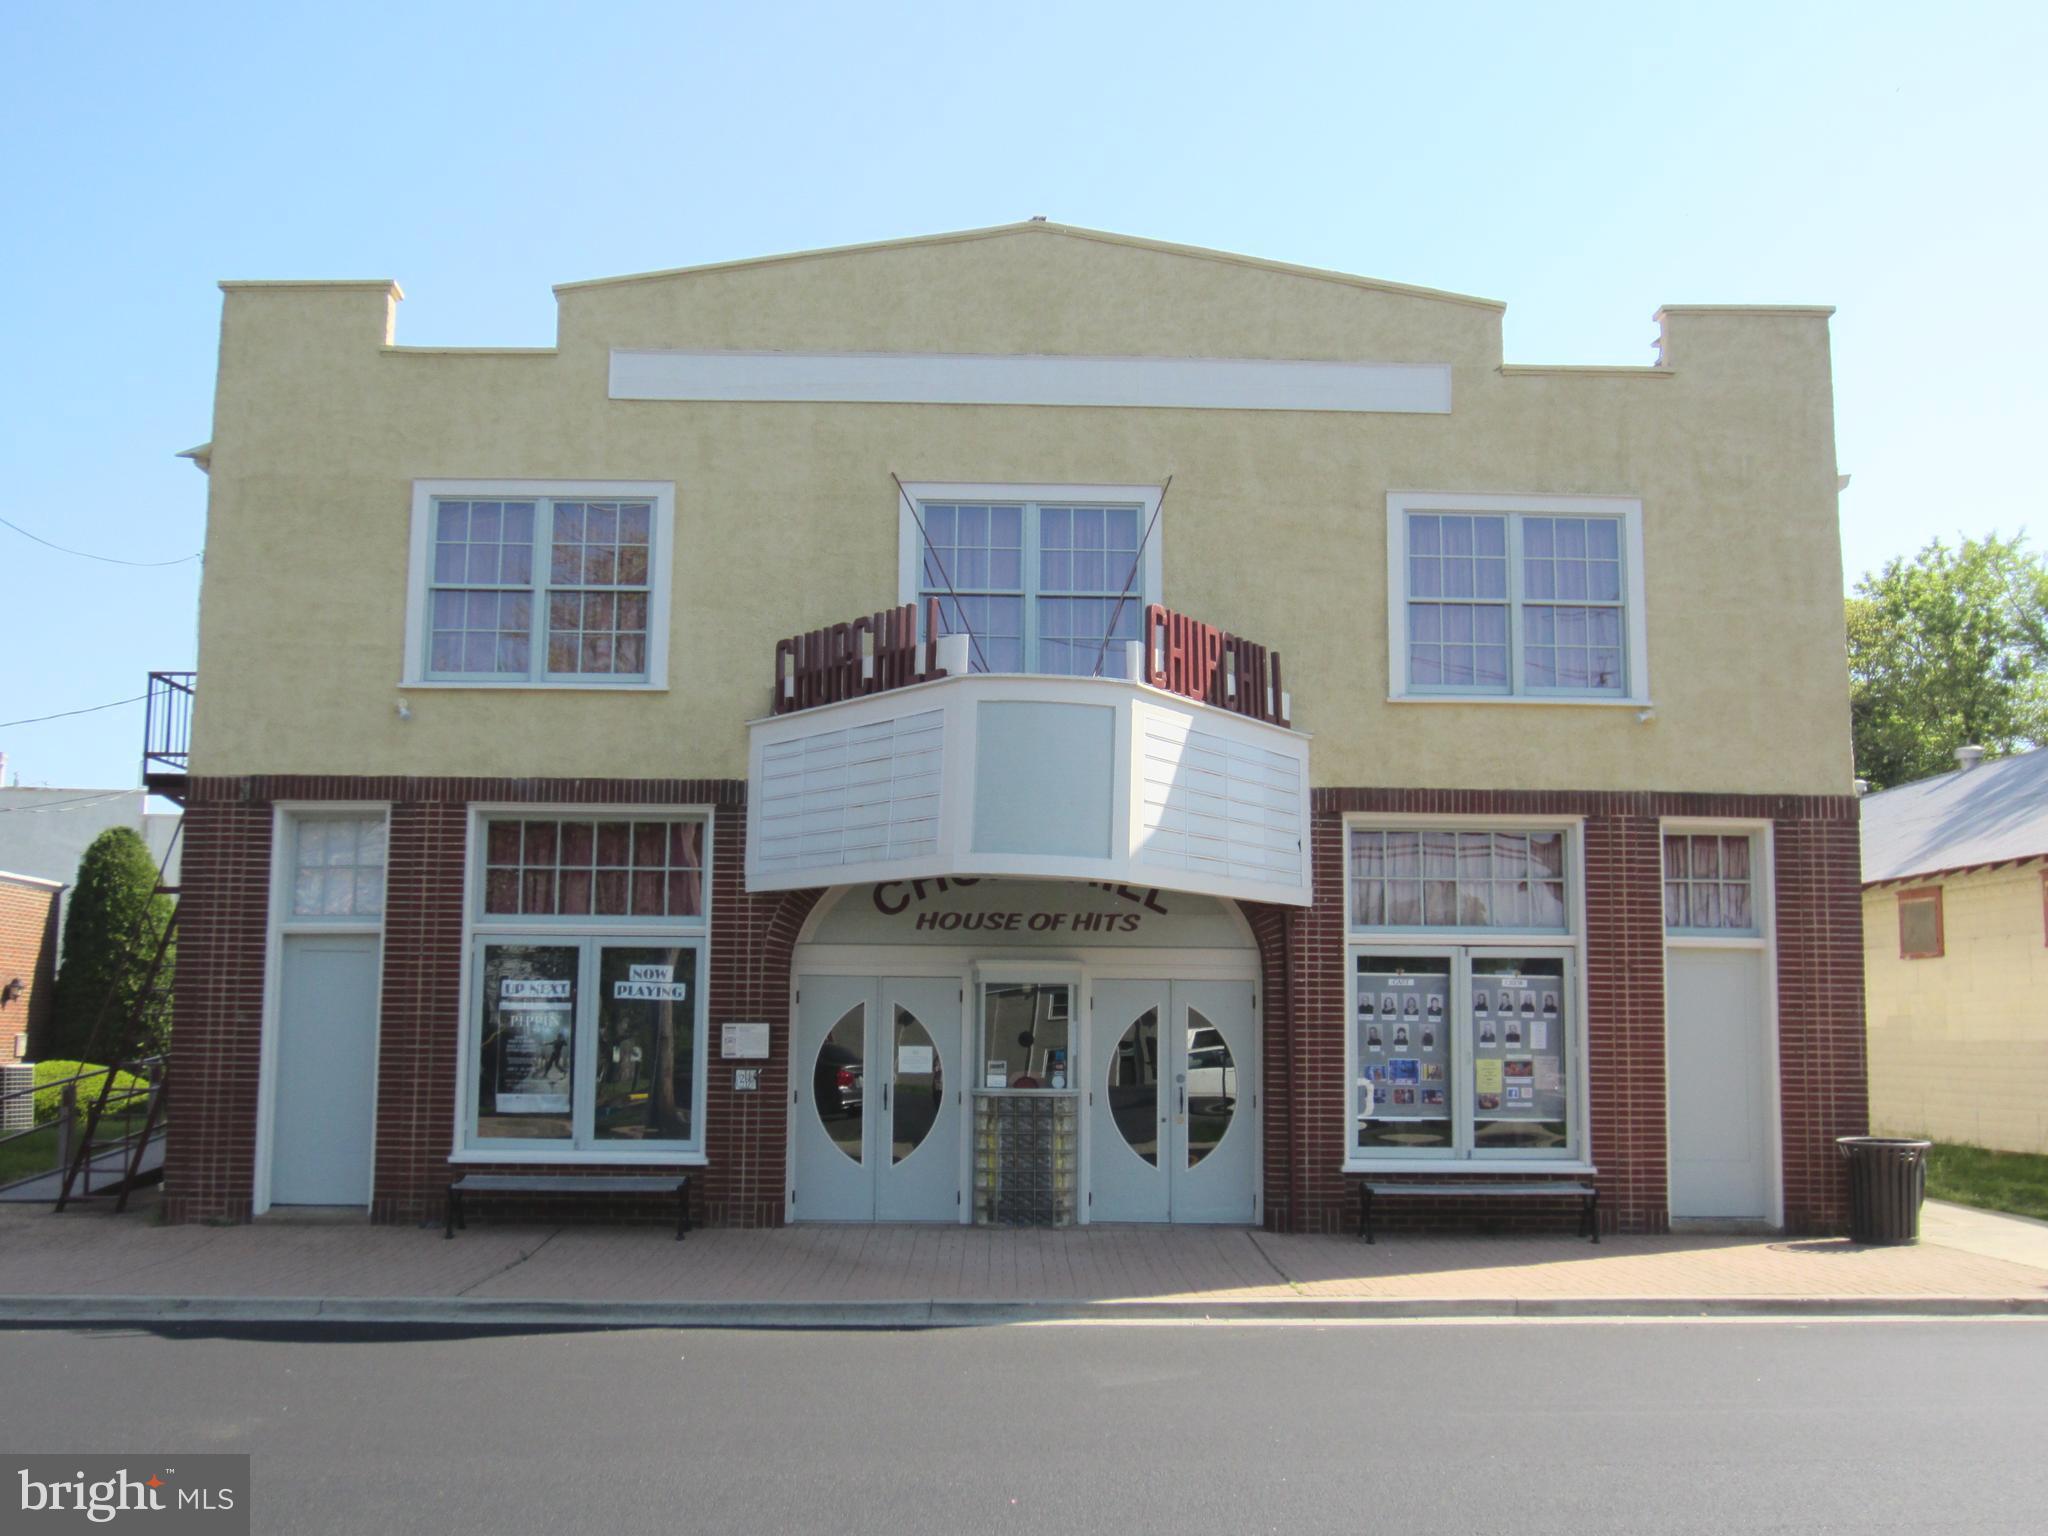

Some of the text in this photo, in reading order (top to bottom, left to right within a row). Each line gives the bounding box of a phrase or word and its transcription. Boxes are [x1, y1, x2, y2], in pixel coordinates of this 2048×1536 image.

[775, 596, 948, 716] CHURCHILL
[1144, 603, 1291, 729] CHURCHILL
[916, 911, 1141, 932] HOUSE OF HITS
[632, 968, 668, 980] NOW
[505, 983, 568, 995] UP NEXT
[617, 985, 683, 998] PLAYING
[510, 1015, 560, 1028] PIPPIN
